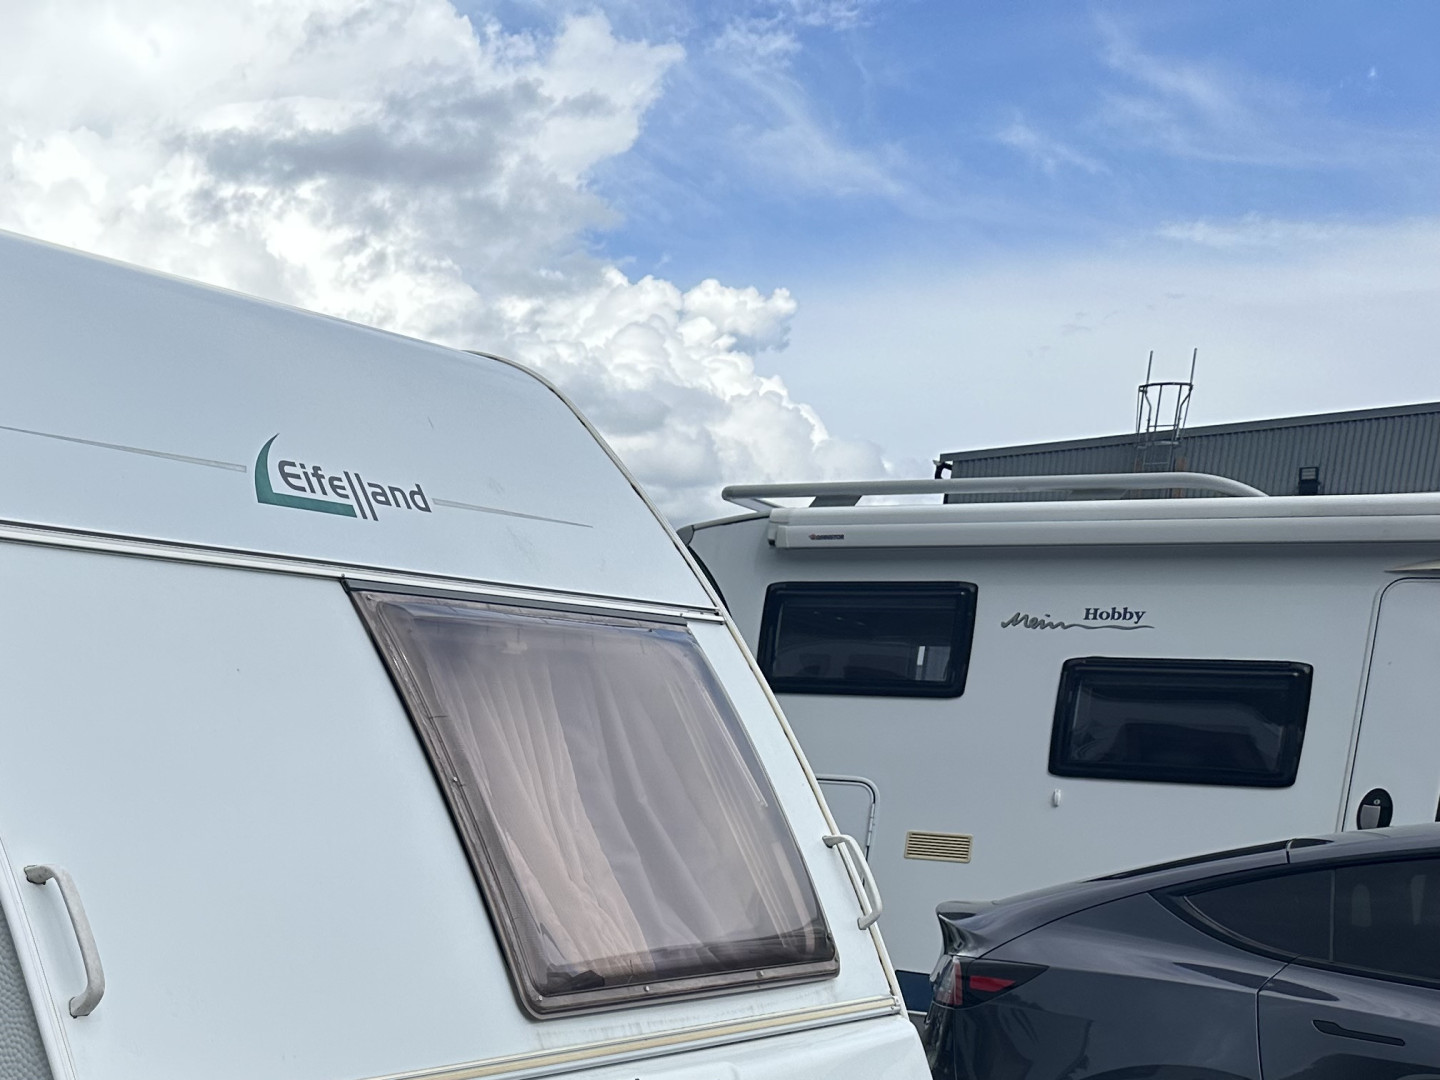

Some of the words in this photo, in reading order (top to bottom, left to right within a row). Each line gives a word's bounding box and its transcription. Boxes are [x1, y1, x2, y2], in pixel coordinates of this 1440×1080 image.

[277, 459, 433, 522] Eifelland
[1000, 611, 1068, 630] Mein
[1083, 606, 1147, 625] Hobby
